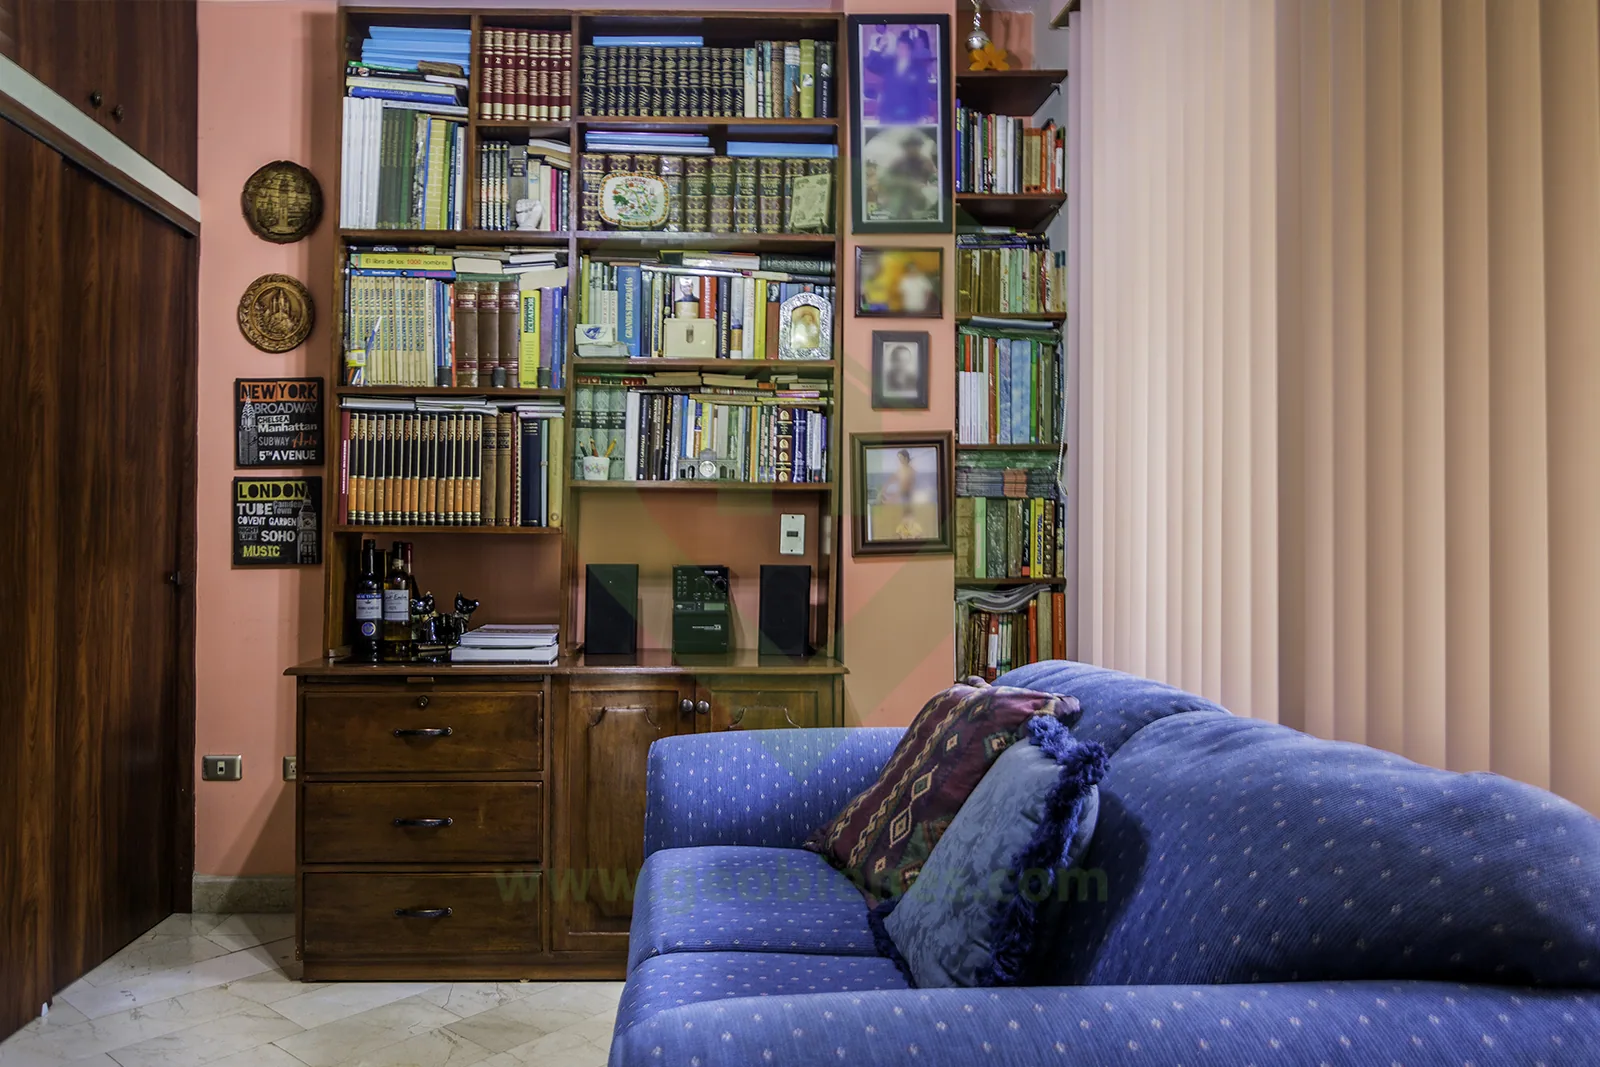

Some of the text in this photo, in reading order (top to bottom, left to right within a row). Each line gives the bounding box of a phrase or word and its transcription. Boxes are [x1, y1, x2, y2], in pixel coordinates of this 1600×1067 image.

[241, 384, 317, 399] NEW YORK
[254, 403, 317, 414] BROADWAY
[258, 415, 289, 423] CHELSEA
[258, 422, 317, 432] Manhattan
[258, 432, 317, 448] SUBWAY Arts
[239, 483, 305, 498] LONDON
[237, 503, 273, 515] TUBE
[237, 516, 296, 526] COVENT GARDEN
[261, 530, 296, 542] SOHO
[243, 545, 280, 557] MUSIC
